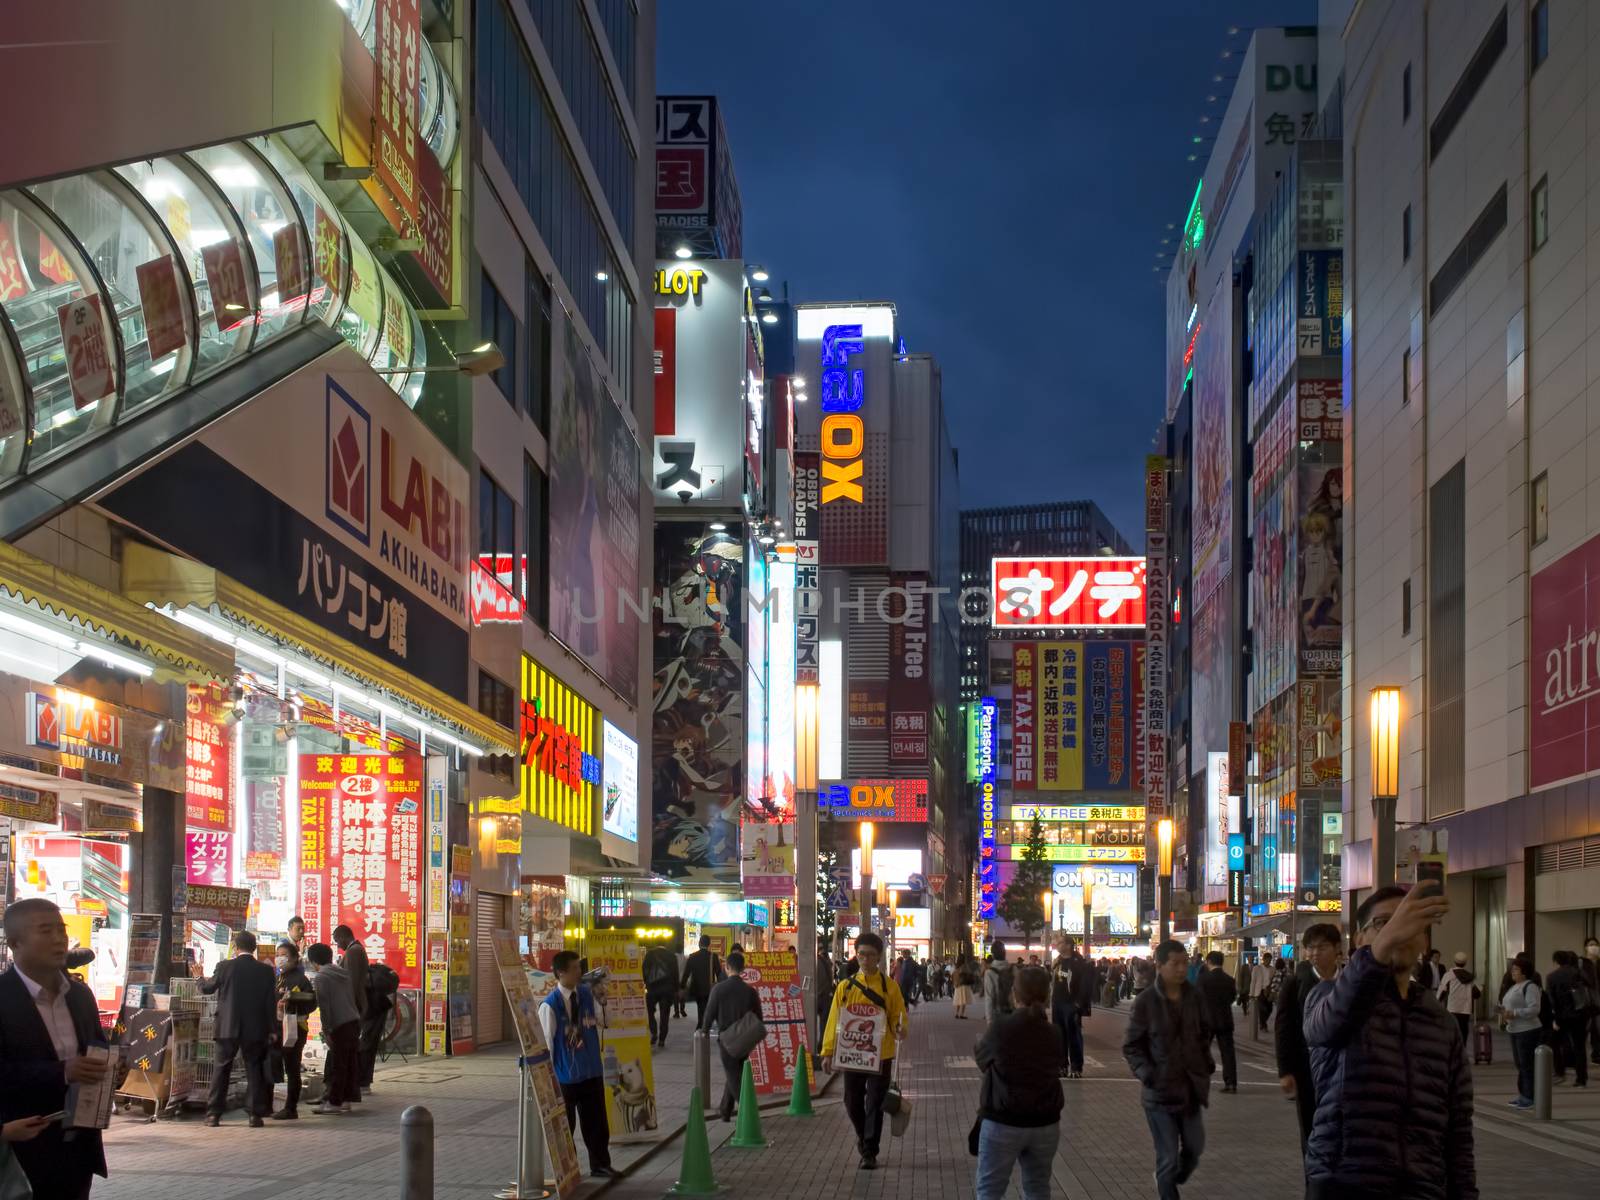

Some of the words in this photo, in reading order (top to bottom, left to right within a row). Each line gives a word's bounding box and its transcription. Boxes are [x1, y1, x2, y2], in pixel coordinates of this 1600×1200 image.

[1300, 334, 1321, 349] 7F
[1303, 425, 1320, 437] 6F
[381, 426, 462, 574] LABI
[380, 530, 467, 619] AKIHABARA
[999, 561, 1146, 618] オノデ
[298, 538, 408, 660] パソコン館
[1150, 557, 1164, 642] TAKARADA
[904, 632, 927, 678] Free
[1015, 648, 1032, 688] 免税
[1062, 648, 1078, 697] 冷蔵庫
[65, 703, 122, 749] LABI
[1015, 690, 1032, 728] TAX
[982, 706, 995, 774] Panasonic
[1015, 731, 1032, 782] FREE
[301, 779, 337, 790] Welcome!
[316, 756, 406, 775] 欢迎光临
[301, 796, 318, 826] TAX
[1020, 808, 1047, 819] TAX
[1050, 808, 1088, 819] FREE
[1090, 808, 1123, 819] 免税店
[301, 830, 317, 870] FREE
[341, 799, 364, 913] 种类繁多。
[1088, 849, 1127, 859] エアコン
[1055, 872, 1134, 888] ONDEN
[851, 1004, 876, 1015] UNO
